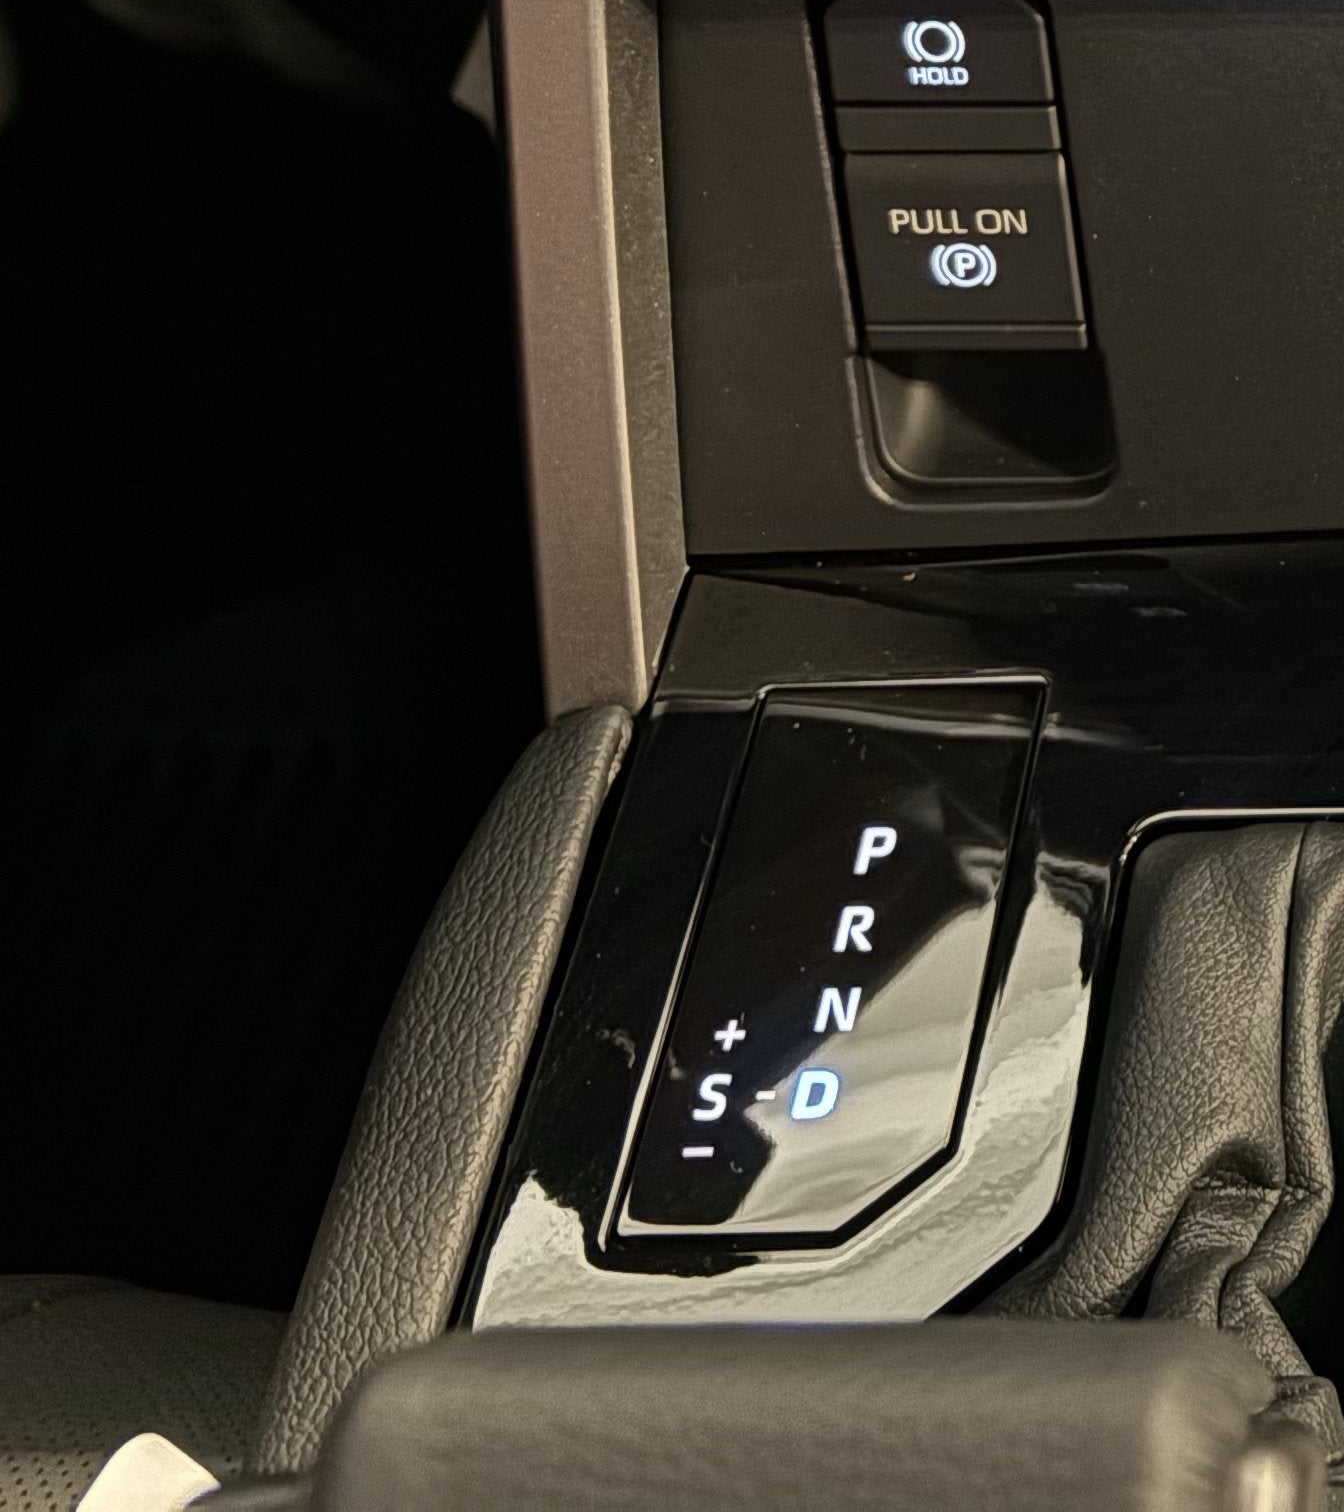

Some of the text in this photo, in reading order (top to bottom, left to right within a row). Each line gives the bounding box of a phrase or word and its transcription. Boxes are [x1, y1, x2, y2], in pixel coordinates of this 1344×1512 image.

[908, 66, 970, 85] HOLD
[887, 208, 1028, 234] PULL ON
[853, 826, 897, 875] P
[833, 905, 875, 952] R
[814, 987, 862, 1032] N
[692, 1073, 733, 1121] S
[791, 1070, 839, 1120] D
